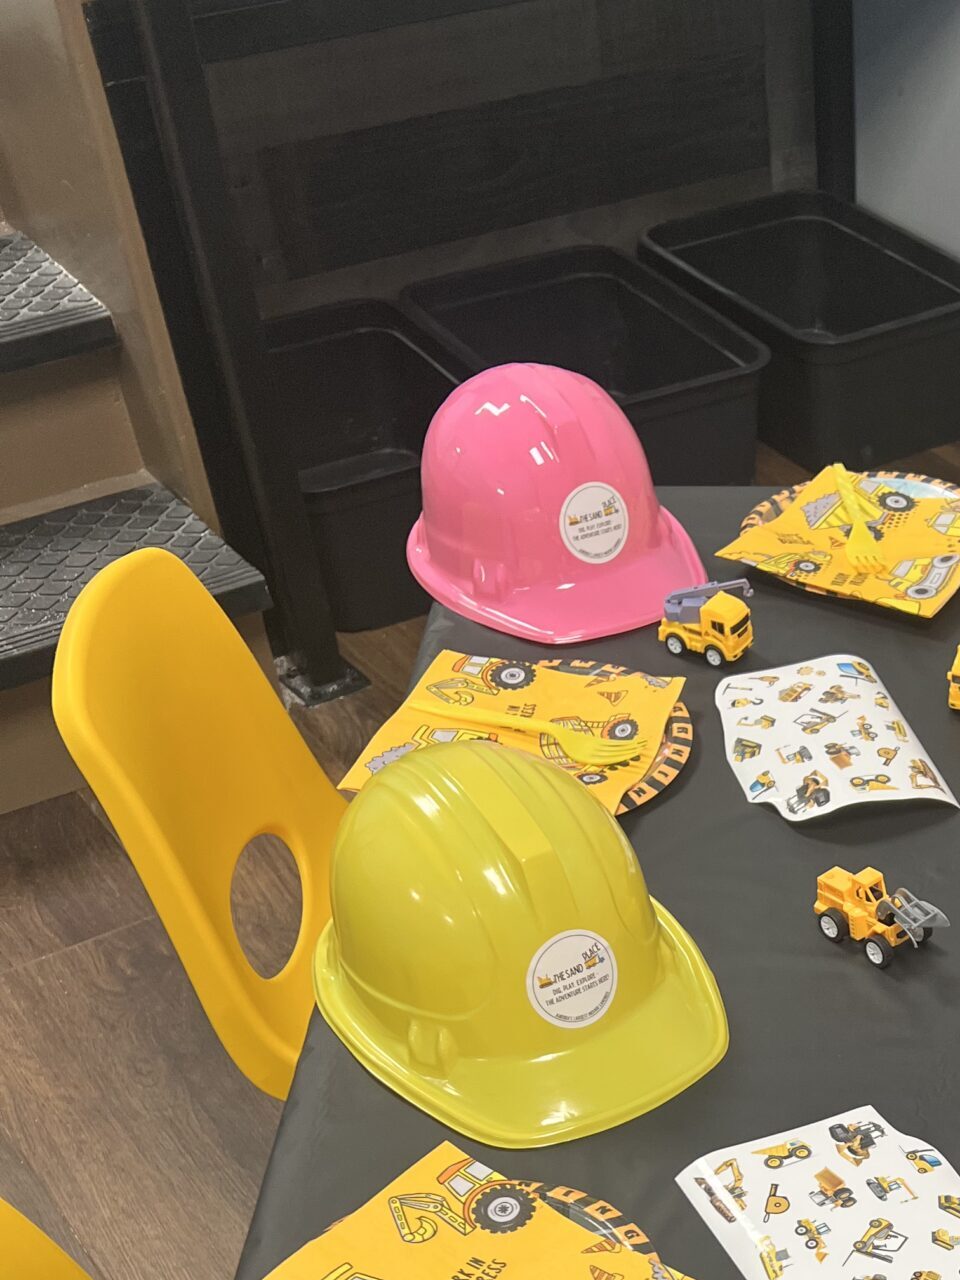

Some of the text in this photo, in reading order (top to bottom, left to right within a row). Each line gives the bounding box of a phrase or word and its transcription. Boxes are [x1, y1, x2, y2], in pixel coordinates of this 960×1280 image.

[566, 964, 583, 978] SAND
[582, 943, 600, 960] PLACE
[466, 1257, 486, 1270] IN
